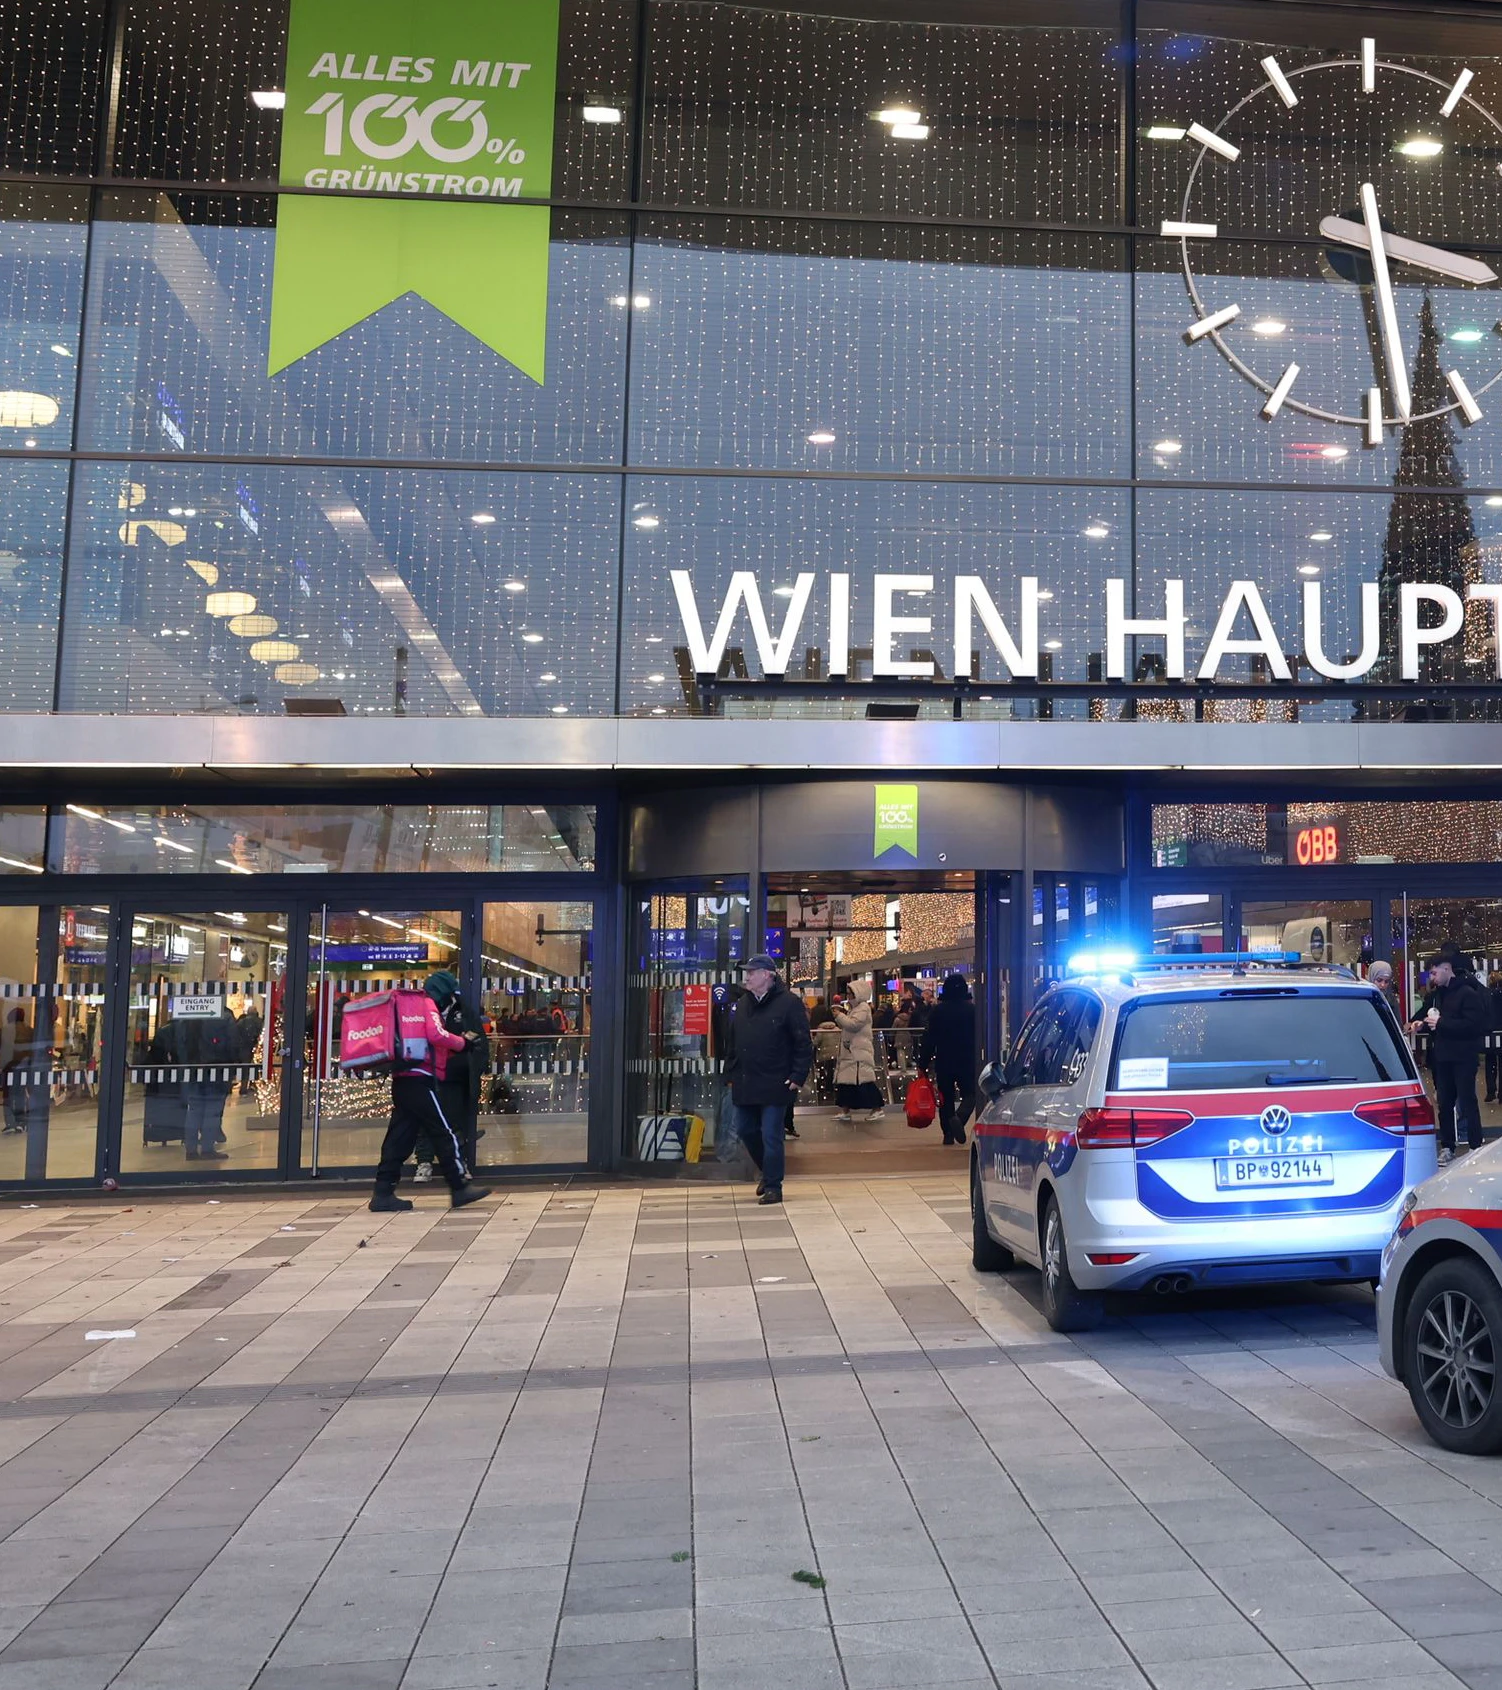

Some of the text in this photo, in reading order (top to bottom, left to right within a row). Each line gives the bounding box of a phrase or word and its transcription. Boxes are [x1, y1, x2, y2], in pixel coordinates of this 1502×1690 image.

[307, 52, 531, 88] ALLES MIT
[304, 92, 525, 164] 100%
[304, 164, 523, 198] GRÜNSTROM
[670, 570, 1038, 677] WIEN
[1261, 854, 1284, 864] Uber
[1297, 826, 1338, 865] ÖBB
[1228, 1135, 1323, 1155] POLIZEI
[993, 1151, 1019, 1185] POLIZEI
[1236, 1159, 1322, 1181] BP 92144
